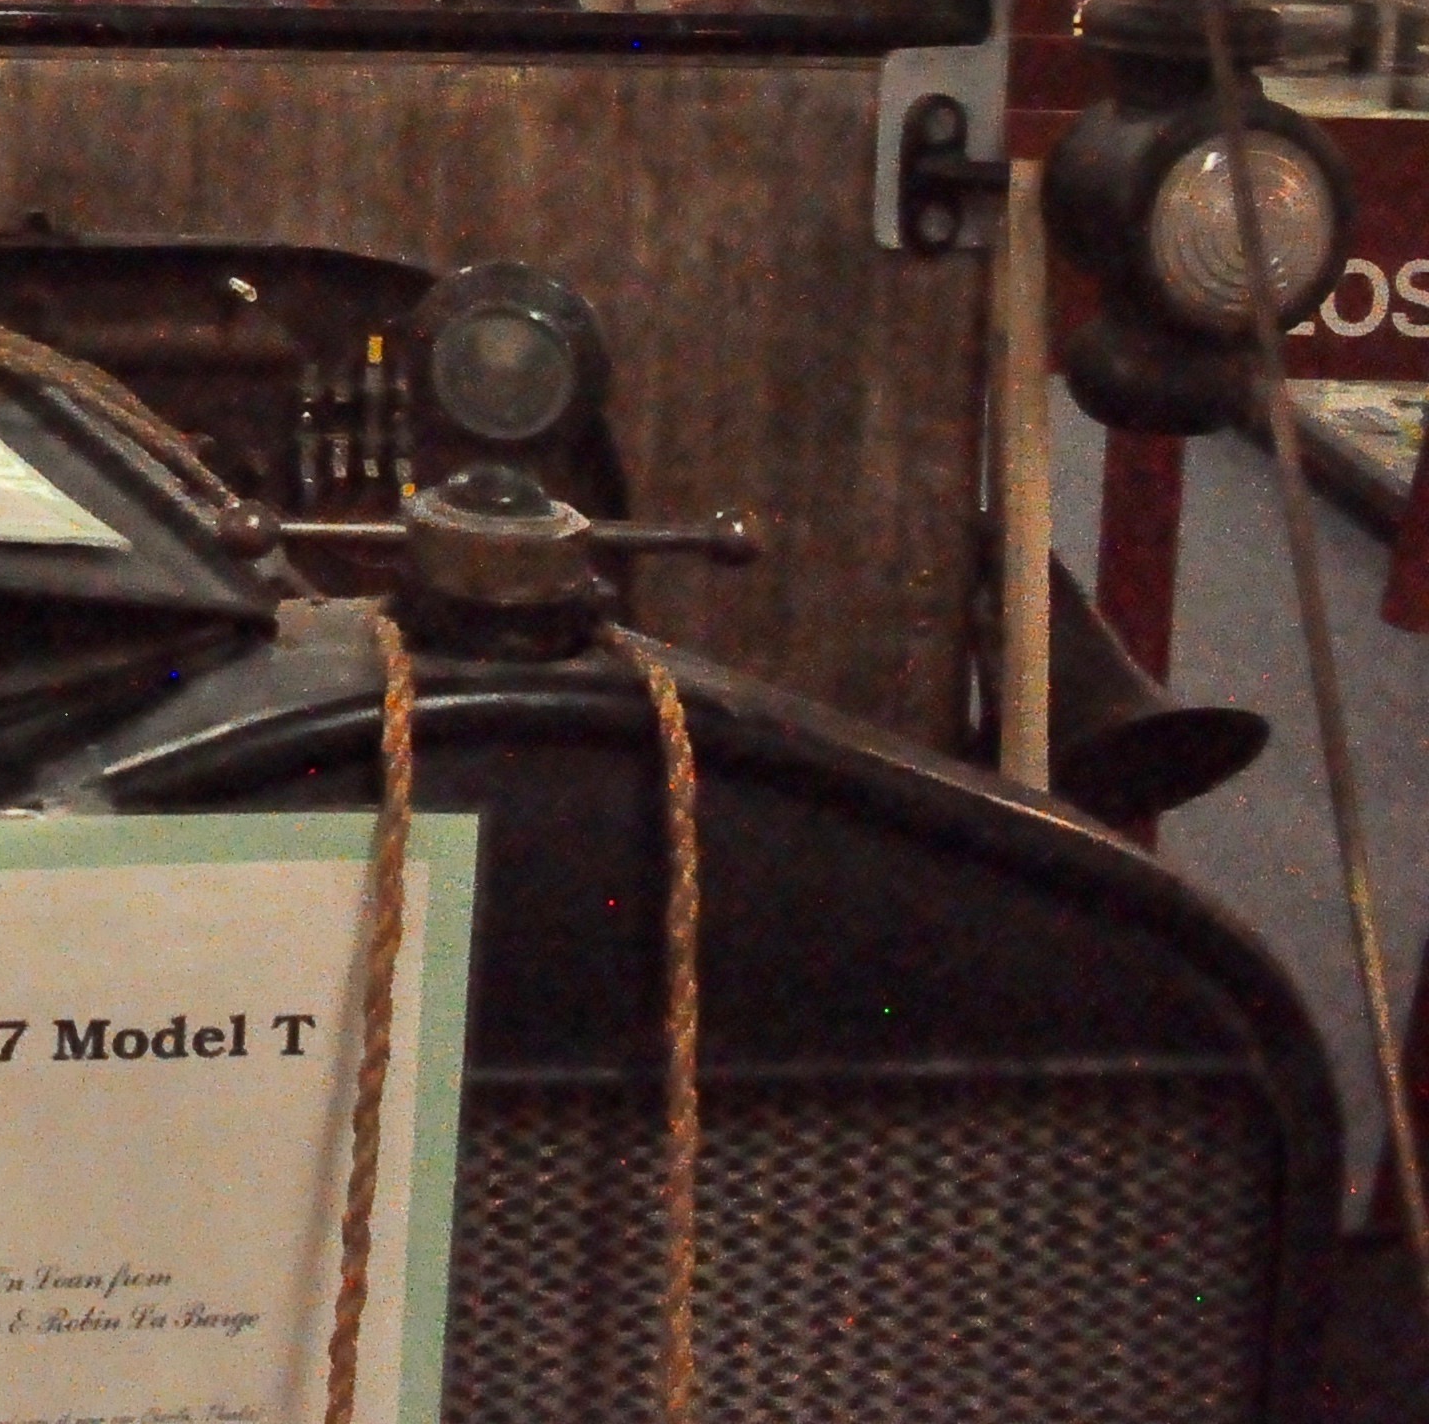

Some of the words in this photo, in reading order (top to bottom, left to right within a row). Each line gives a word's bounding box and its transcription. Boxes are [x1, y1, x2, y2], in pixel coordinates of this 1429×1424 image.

[51, 1014, 248, 1063] Model
[271, 1014, 317, 1058] T
[32, 1264, 102, 1291] Loan
[103, 1260, 173, 1299] from
[37, 1305, 121, 1334] Robin
